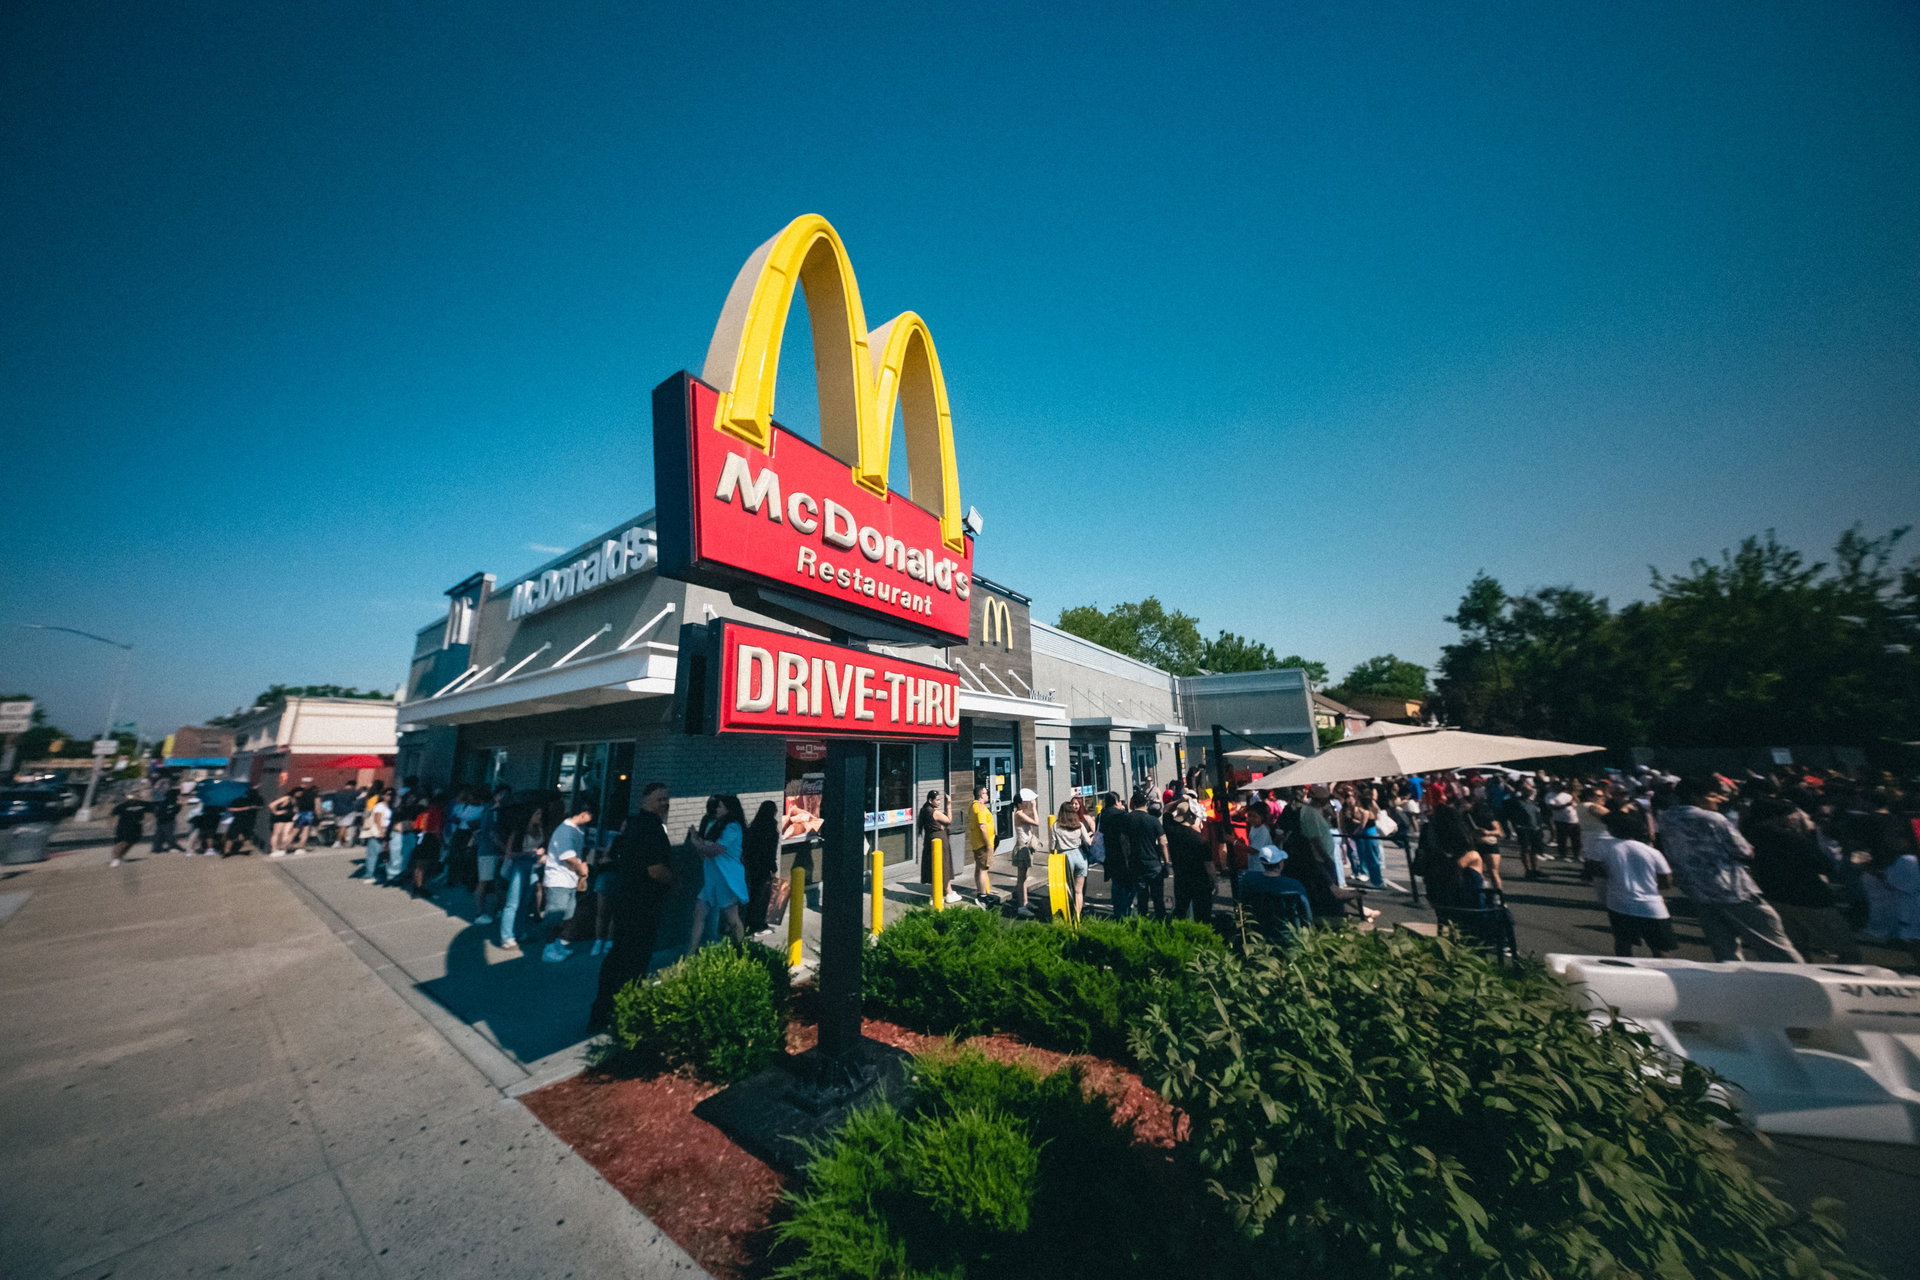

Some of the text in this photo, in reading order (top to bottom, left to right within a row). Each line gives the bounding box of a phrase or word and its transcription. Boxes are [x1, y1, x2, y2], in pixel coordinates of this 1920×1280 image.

[715, 451, 970, 601] McDonald's
[507, 527, 657, 621] McDonald's
[797, 545, 933, 616] Restaurant
[736, 644, 960, 728] DRIVE-THRU
